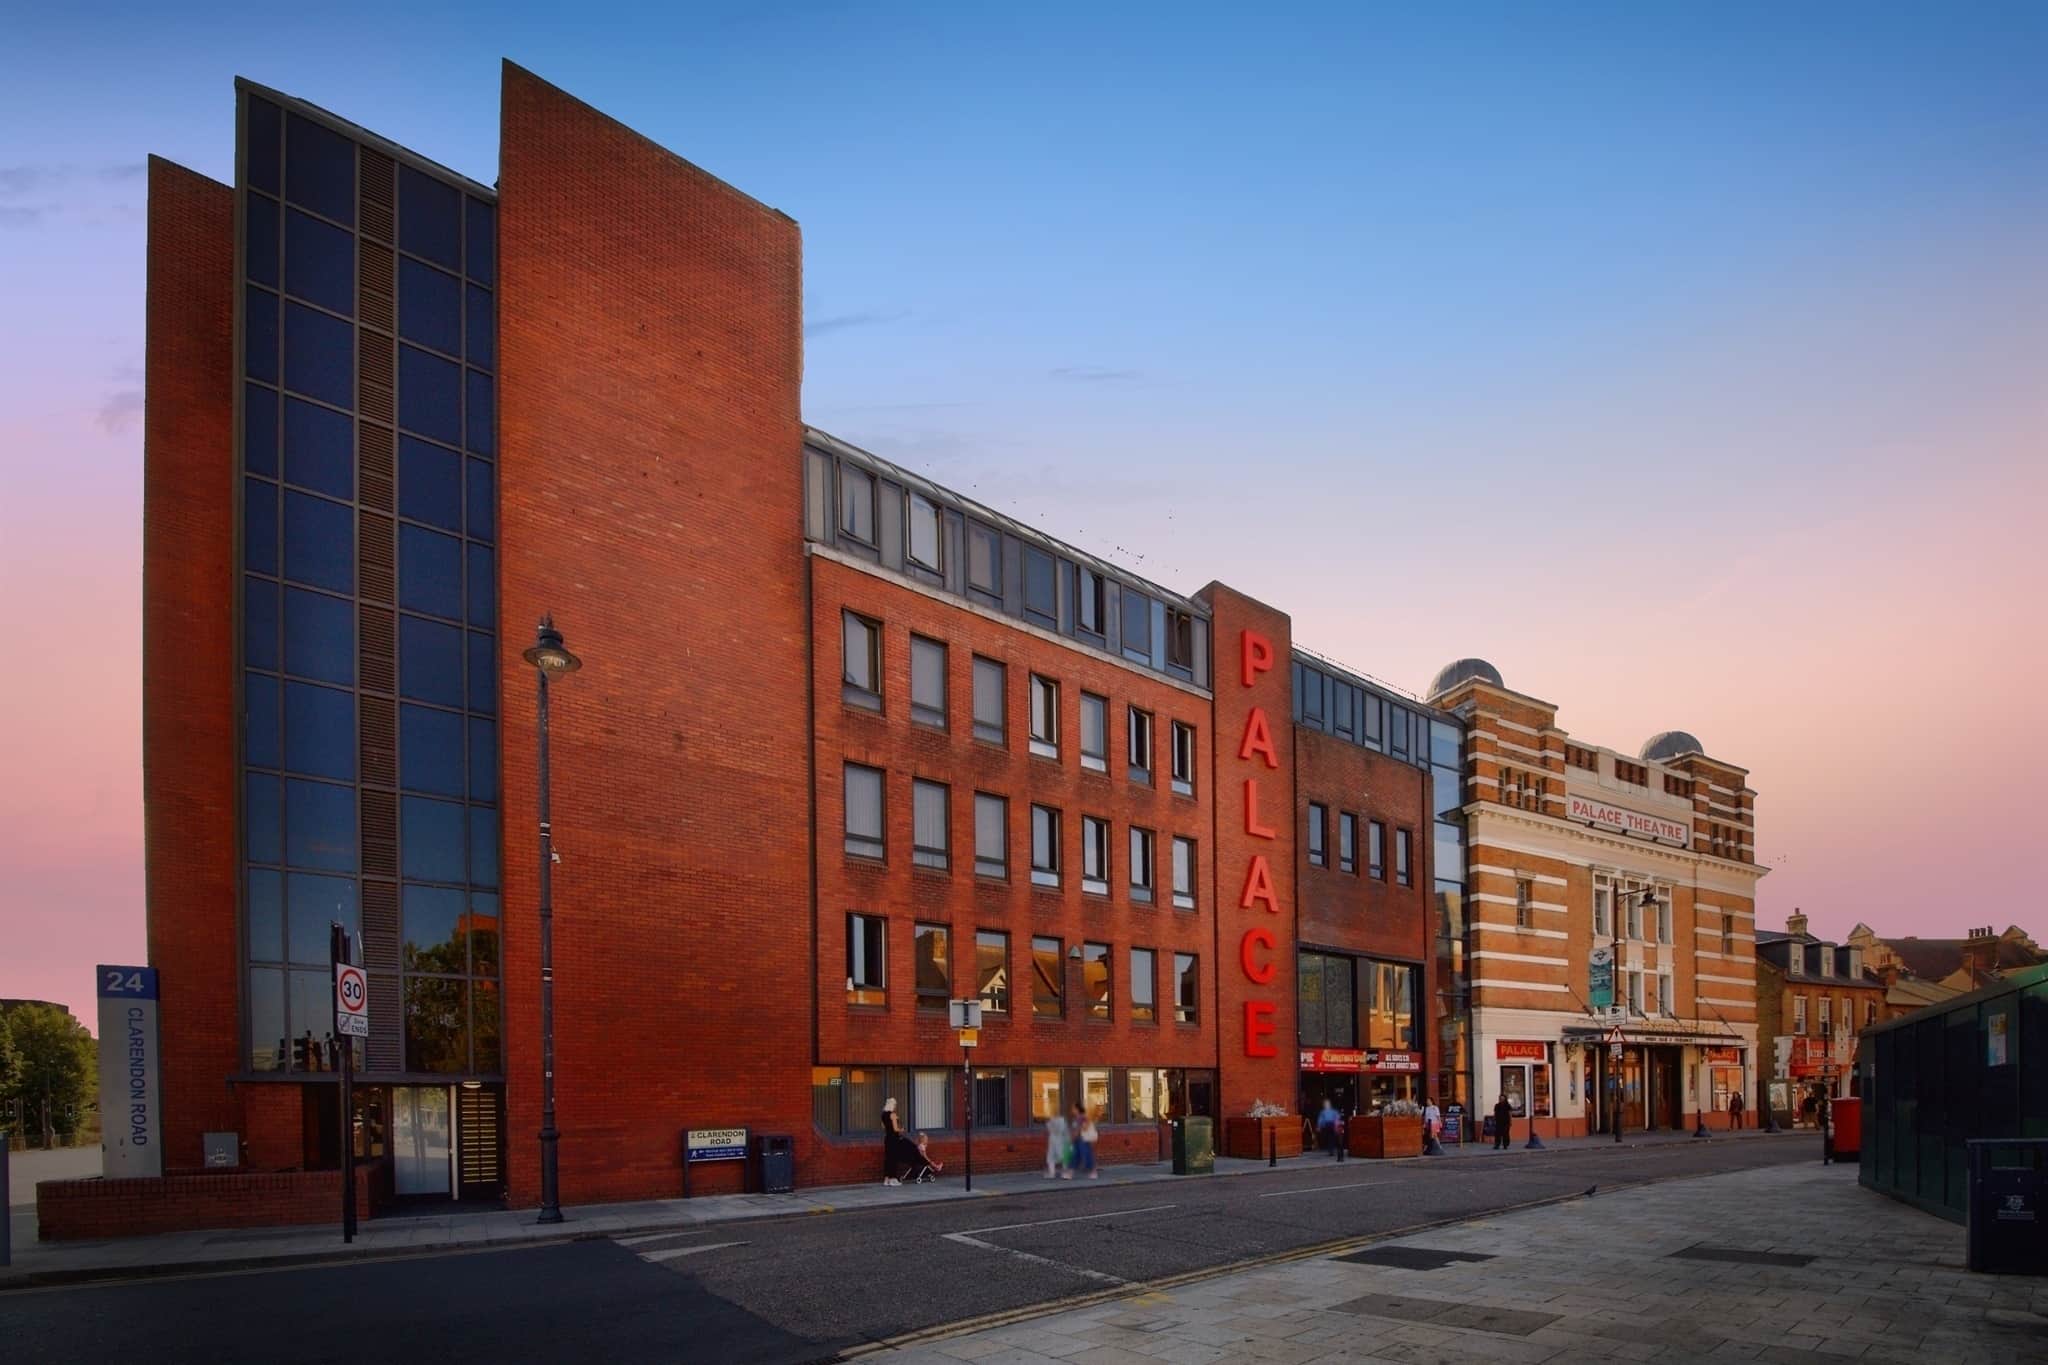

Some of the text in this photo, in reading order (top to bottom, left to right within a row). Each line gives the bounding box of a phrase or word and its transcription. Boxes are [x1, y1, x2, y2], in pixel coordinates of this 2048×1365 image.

[1573, 800, 1683, 840] PALACE THEATRE
[1239, 629, 1280, 1058] PALACE
[106, 971, 145, 993] 24
[343, 981, 362, 1000] 30
[1501, 1045, 1541, 1056] PALACE
[127, 1007, 148, 1147] CLARENDON ROAD
[696, 1130, 745, 1139] CLARENDON
